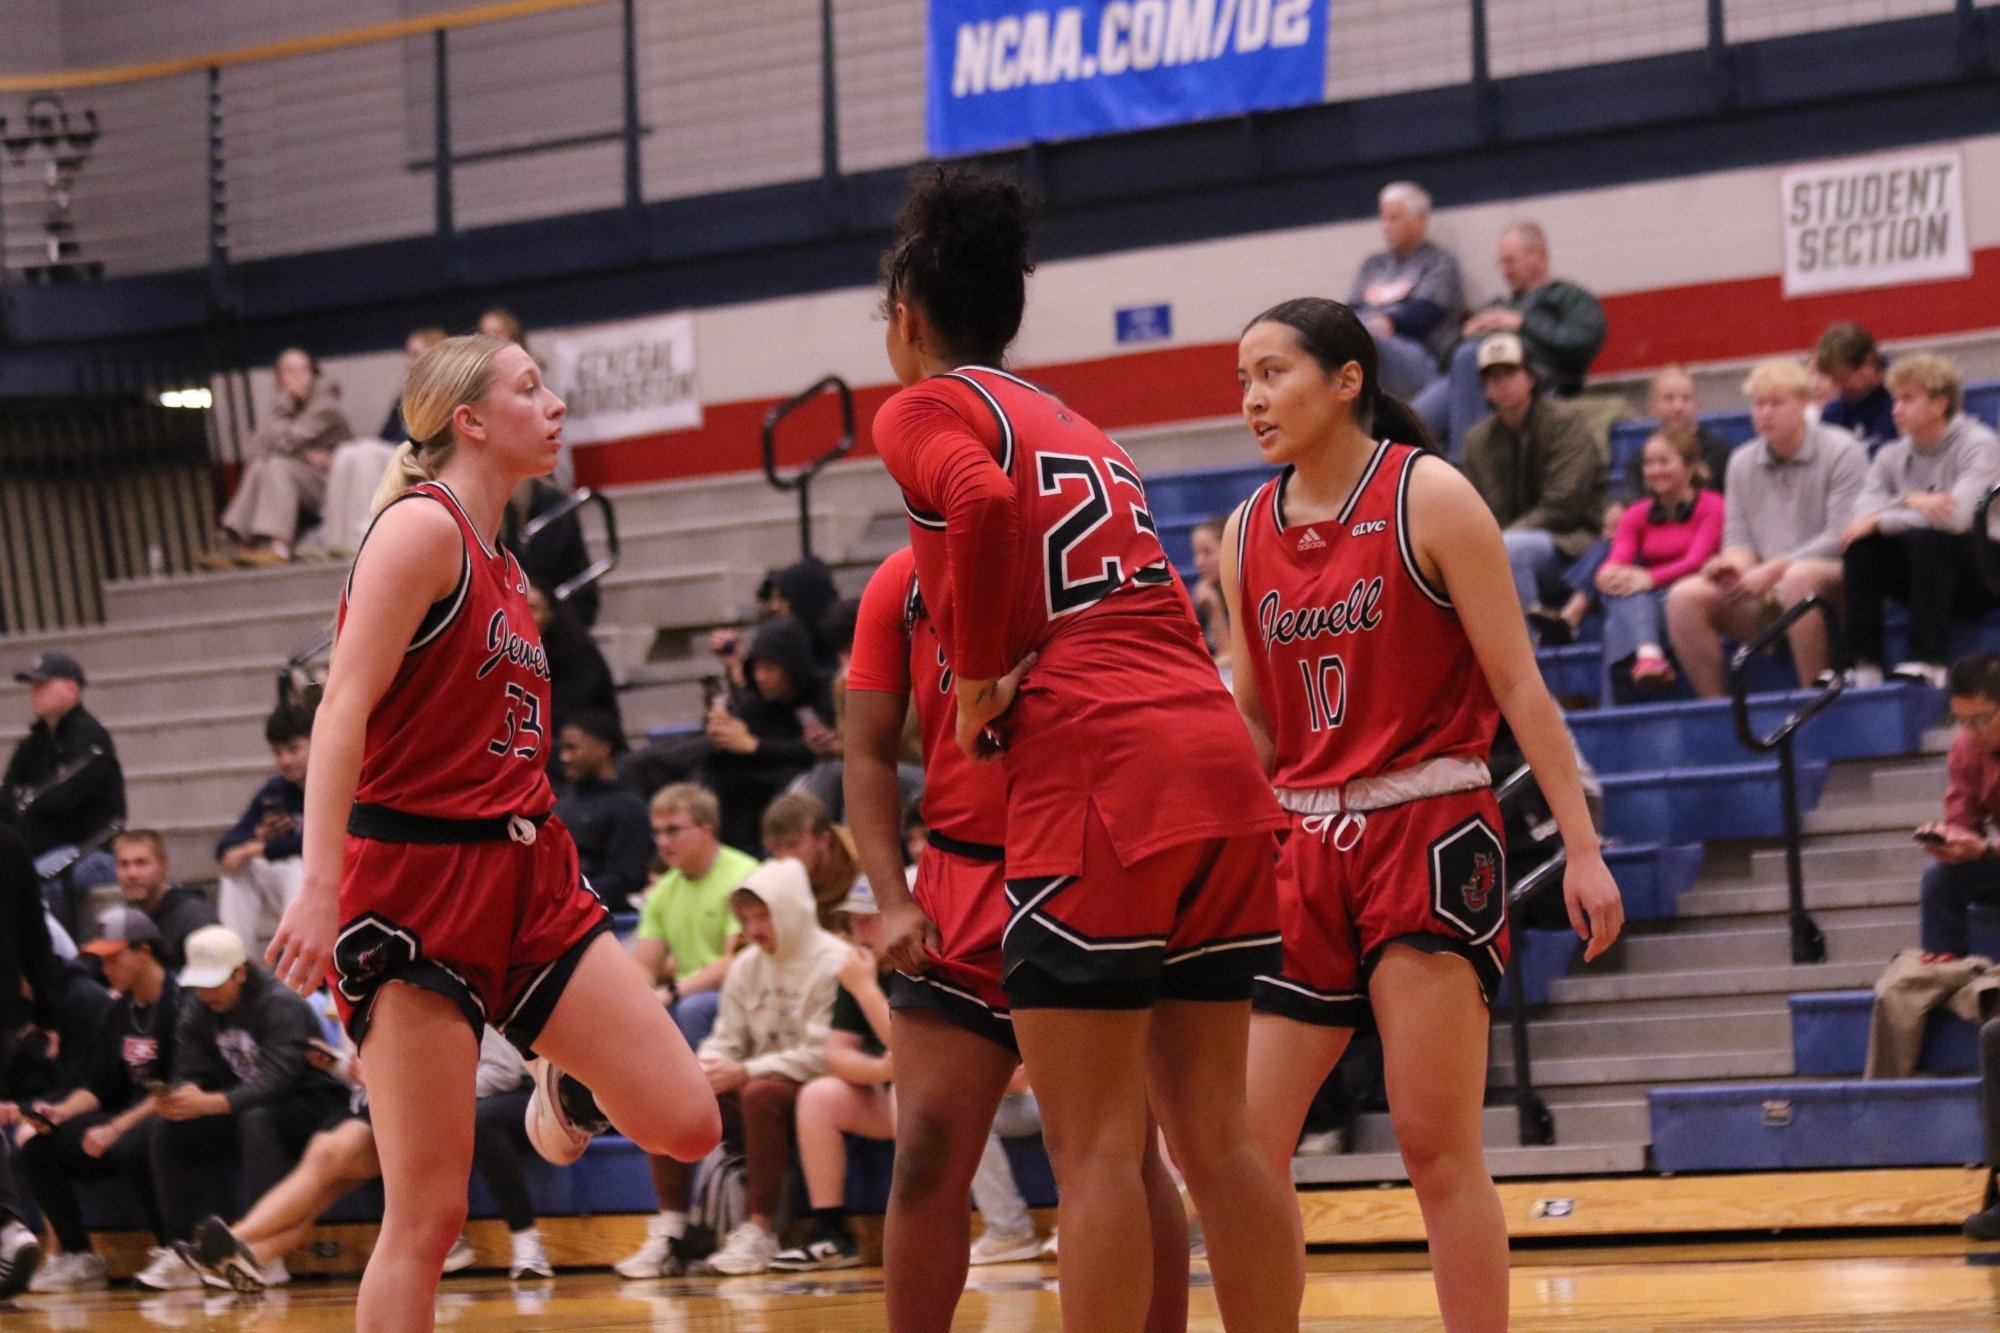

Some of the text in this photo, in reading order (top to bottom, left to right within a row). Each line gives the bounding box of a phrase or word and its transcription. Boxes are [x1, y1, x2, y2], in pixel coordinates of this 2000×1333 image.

[1790, 163, 1951, 226] STUDENT
[1797, 213, 1949, 273] SECTION
[1034, 450, 1176, 622] 23
[1297, 540, 1327, 551] adidas
[1351, 519, 1387, 537] GLVC
[1258, 576, 1383, 661] Jewell
[487, 681, 543, 761] 33
[1298, 654, 1346, 733] 10
